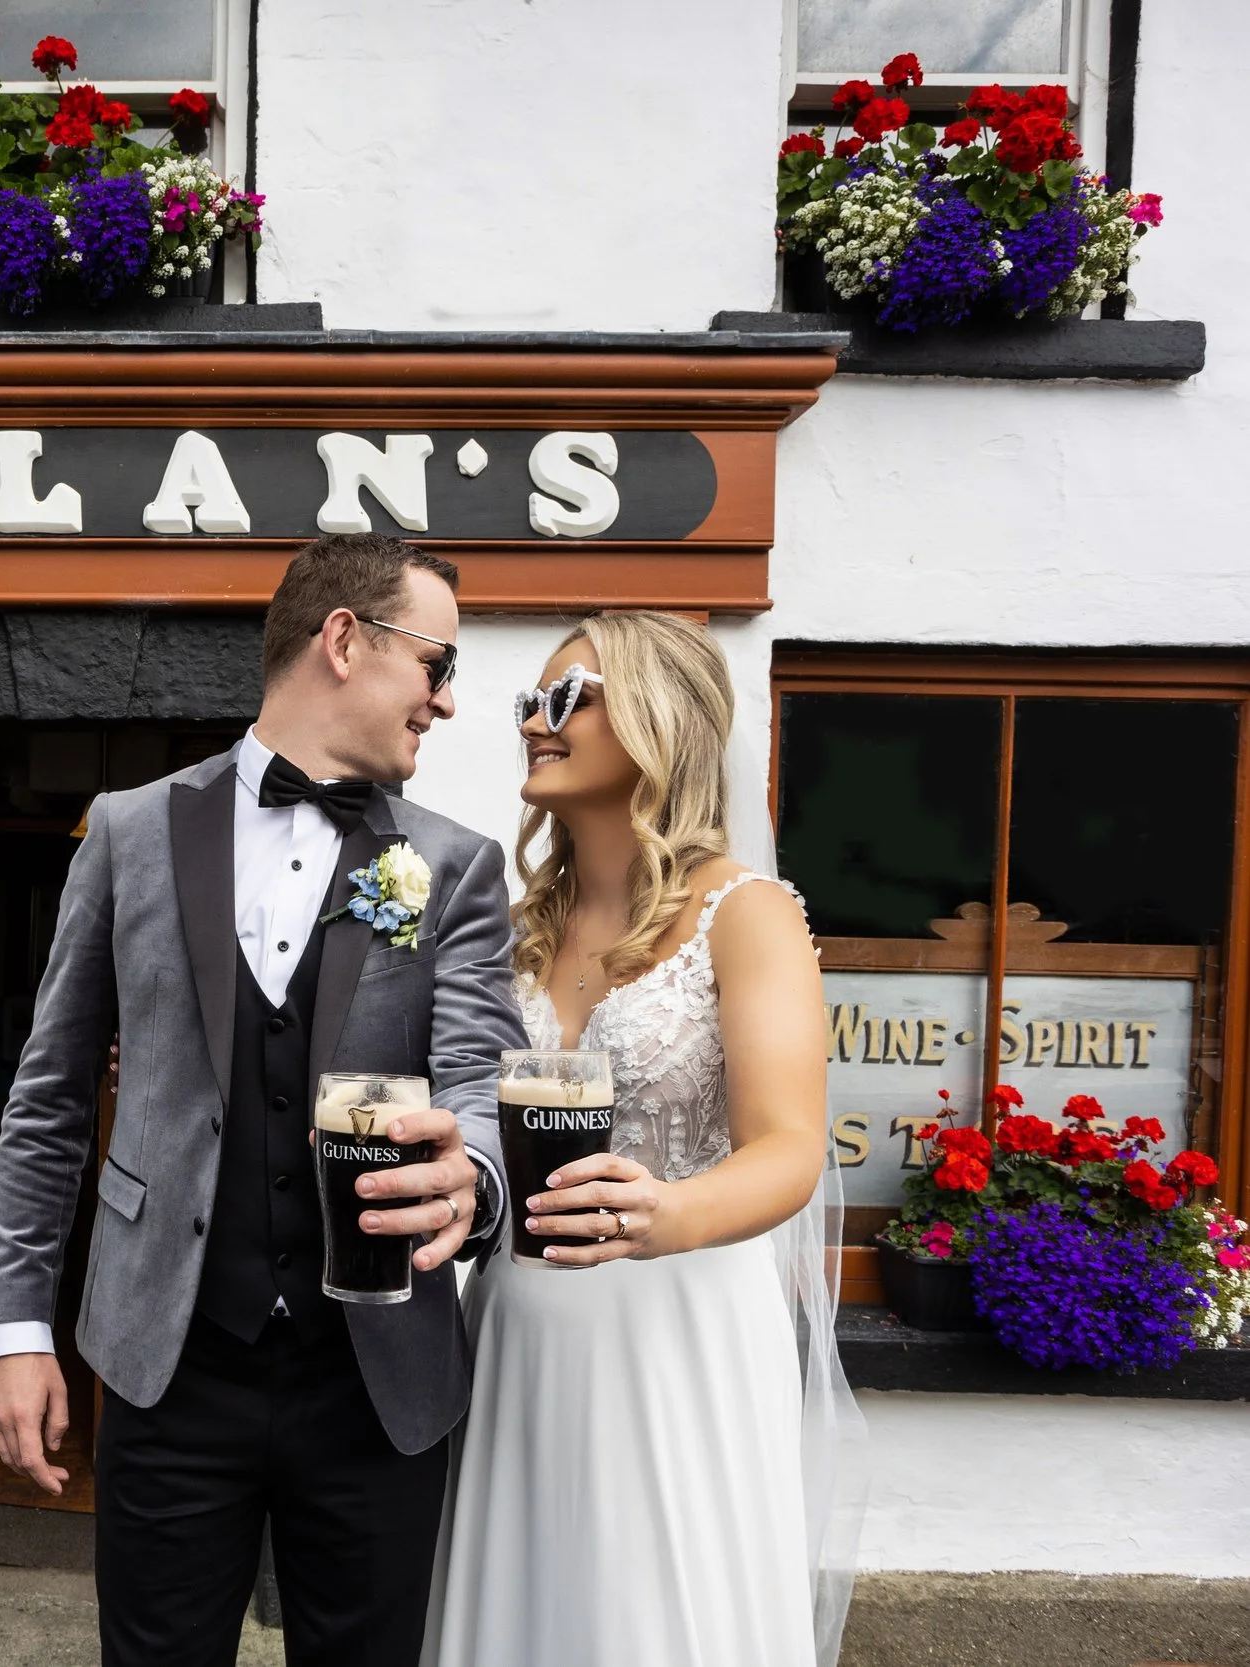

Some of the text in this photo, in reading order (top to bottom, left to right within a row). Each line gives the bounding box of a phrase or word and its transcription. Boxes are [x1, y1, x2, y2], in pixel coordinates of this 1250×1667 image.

[824, 999, 1157, 1069] WINE SPIRIT
[523, 1106, 612, 1131] GUINNESS
[323, 1141, 400, 1162] GUINNESS
